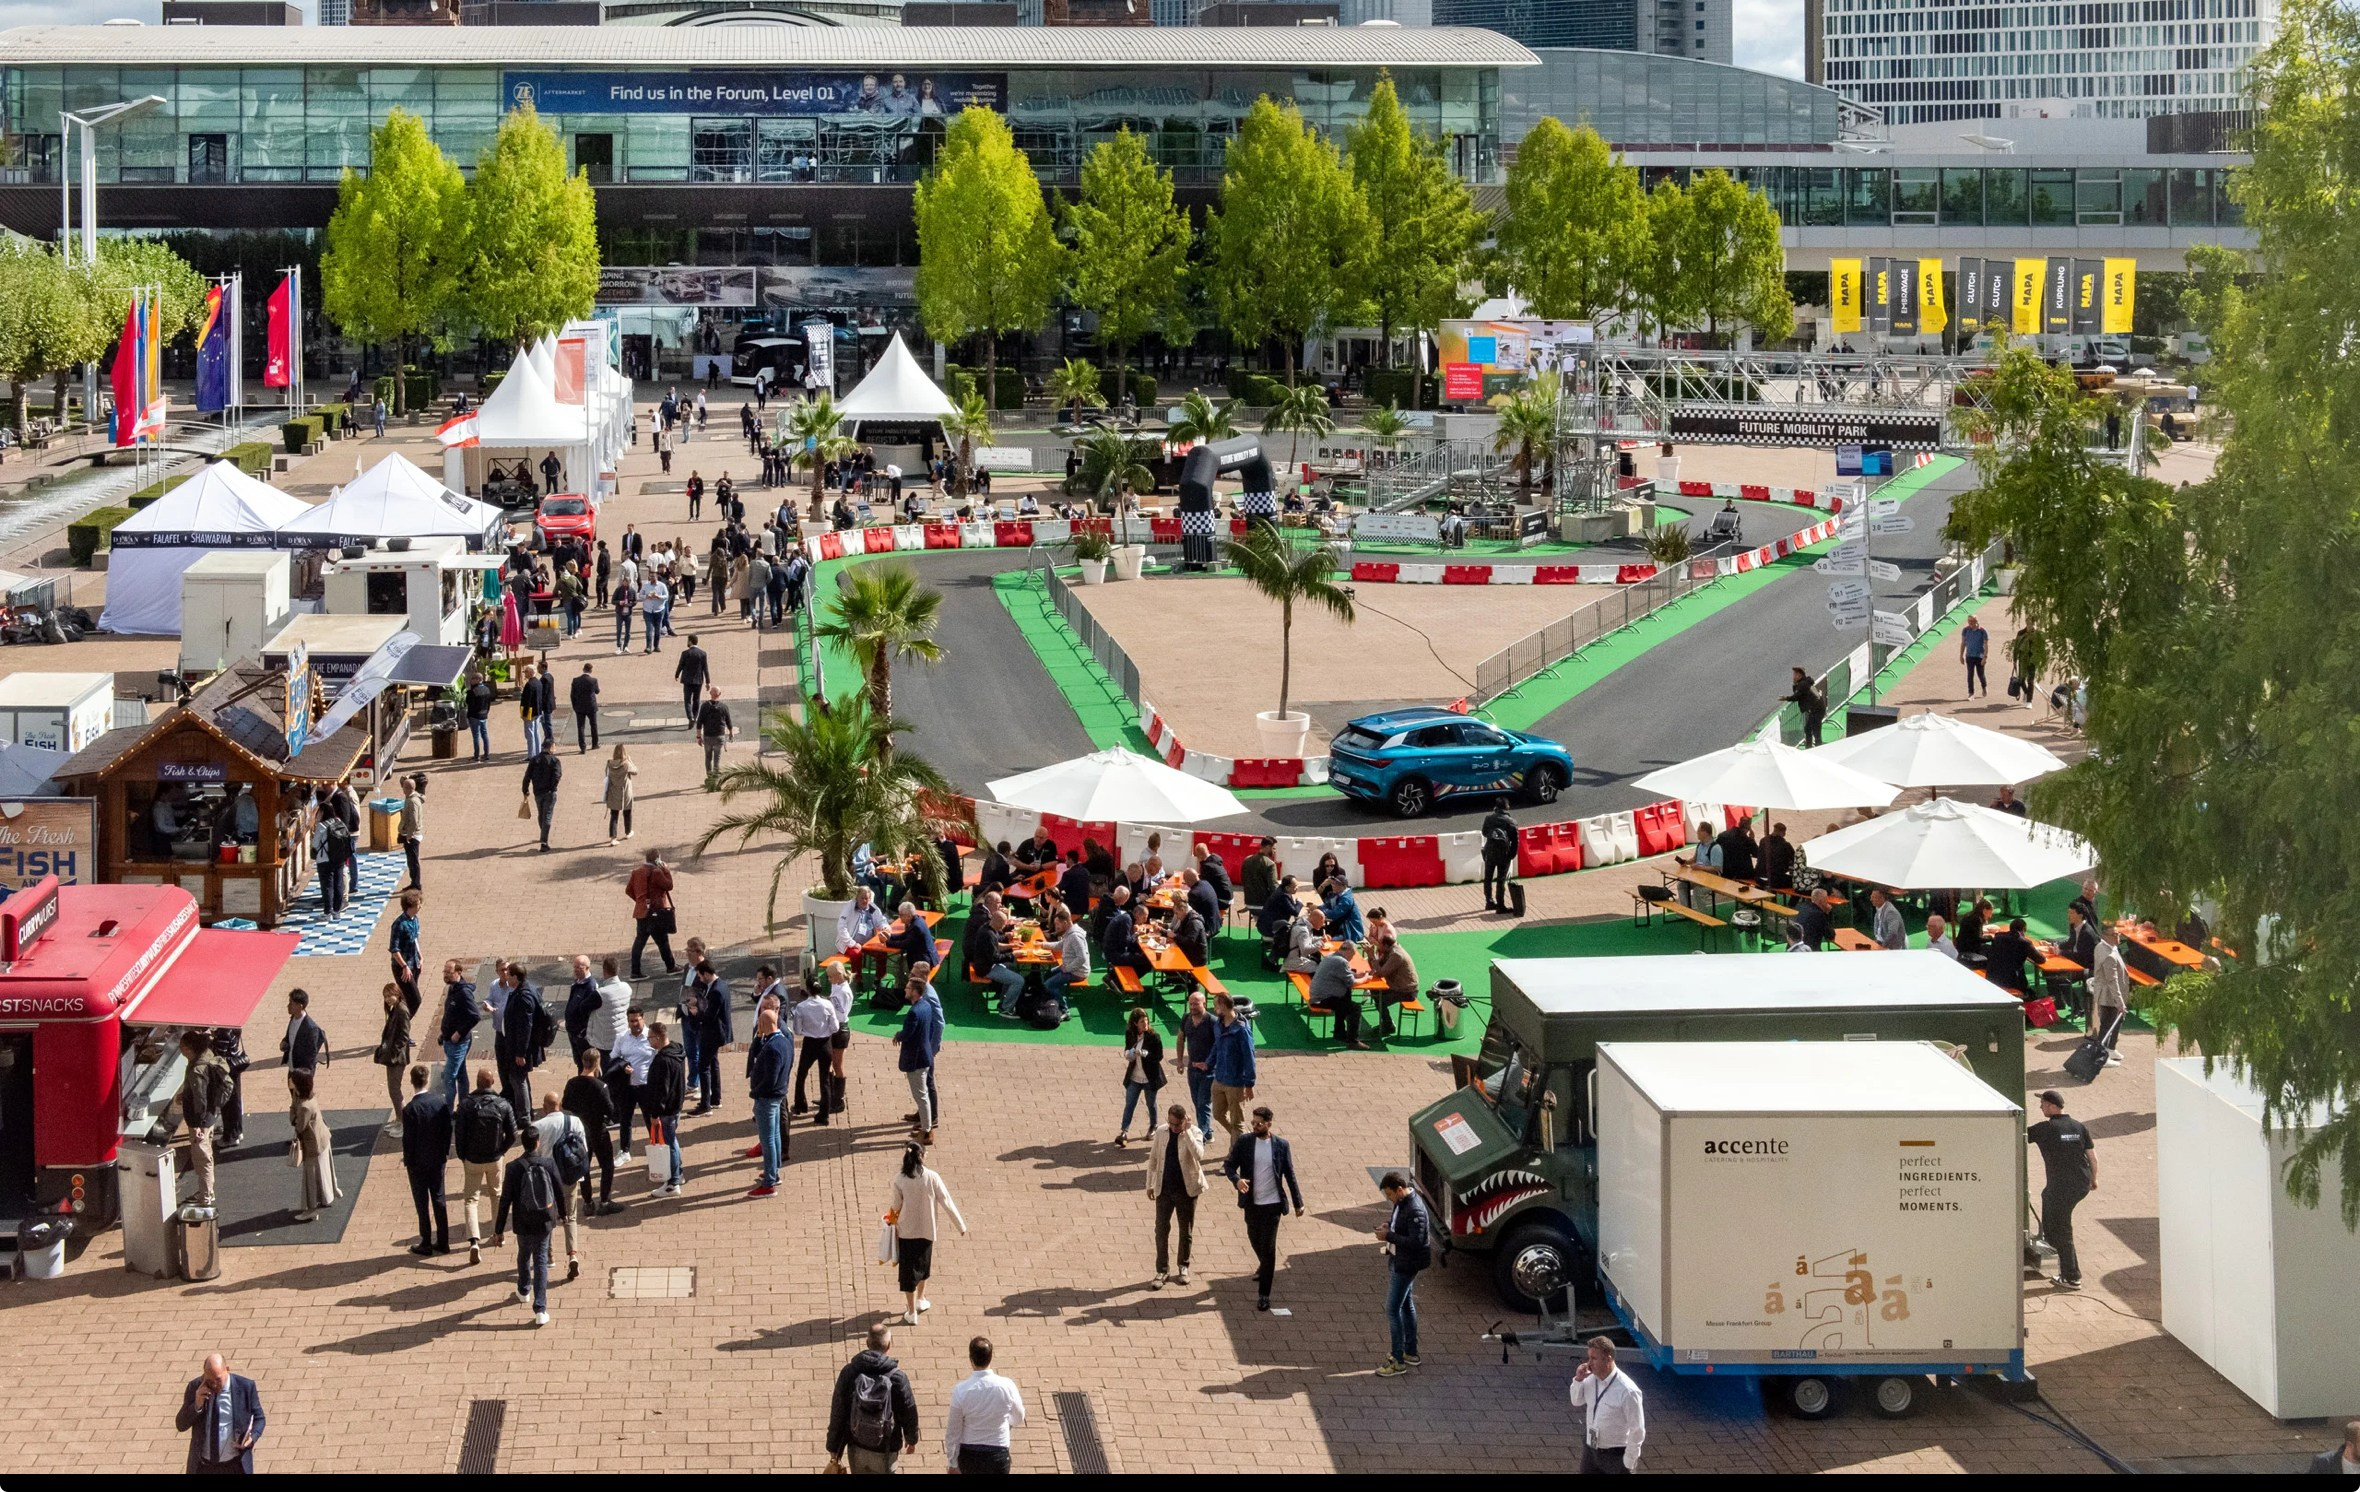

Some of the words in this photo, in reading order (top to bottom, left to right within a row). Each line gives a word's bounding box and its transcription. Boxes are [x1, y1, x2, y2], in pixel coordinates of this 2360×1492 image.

[610, 86, 645, 100] Find
[647, 88, 666, 100] us
[669, 86, 685, 100] in
[687, 86, 713, 100] the
[716, 86, 769, 102] Forum,
[773, 86, 814, 100] Level
[817, 87, 835, 100] 01
[1840, 273, 1849, 306] MAPA
[1877, 270, 1887, 305] MAPA
[1901, 268, 1909, 314] EMBRAYAGE
[1926, 273, 1936, 306] MAPA
[1967, 272, 1977, 304] CLUTCH
[1992, 275, 2002, 308] CLUTCH
[2022, 272, 2034, 306] MAPA
[2056, 265, 2066, 309] KUPPLUNG
[2080, 273, 2094, 308] MAPA
[2114, 272, 2124, 306] MAPA
[1739, 421, 1780, 434] FUTURE
[1783, 424, 1835, 436] MOBILITY
[1838, 425, 1868, 437] PARK
[153, 534, 181, 544] FALAFEL
[190, 533, 232, 544] SHAWARMA
[1875, 631, 1884, 639] 12.1
[164, 765, 186, 776] Fish
[187, 766, 196, 776] &
[196, 765, 221, 779] Chips
[27, 825, 75, 845] Fresh
[18, 896, 57, 945] CURRYWURST
[0, 998, 84, 1012] STSNACKS
[1704, 1137, 1789, 1154] accente
[1899, 1155, 1942, 1168] perfect
[1899, 1172, 1981, 1183] INGREDIENTS,
[1899, 1185, 1942, 1198] perfect
[1899, 1202, 1963, 1212] MOMENTS.
[1754, 1320, 1772, 1328] Group
